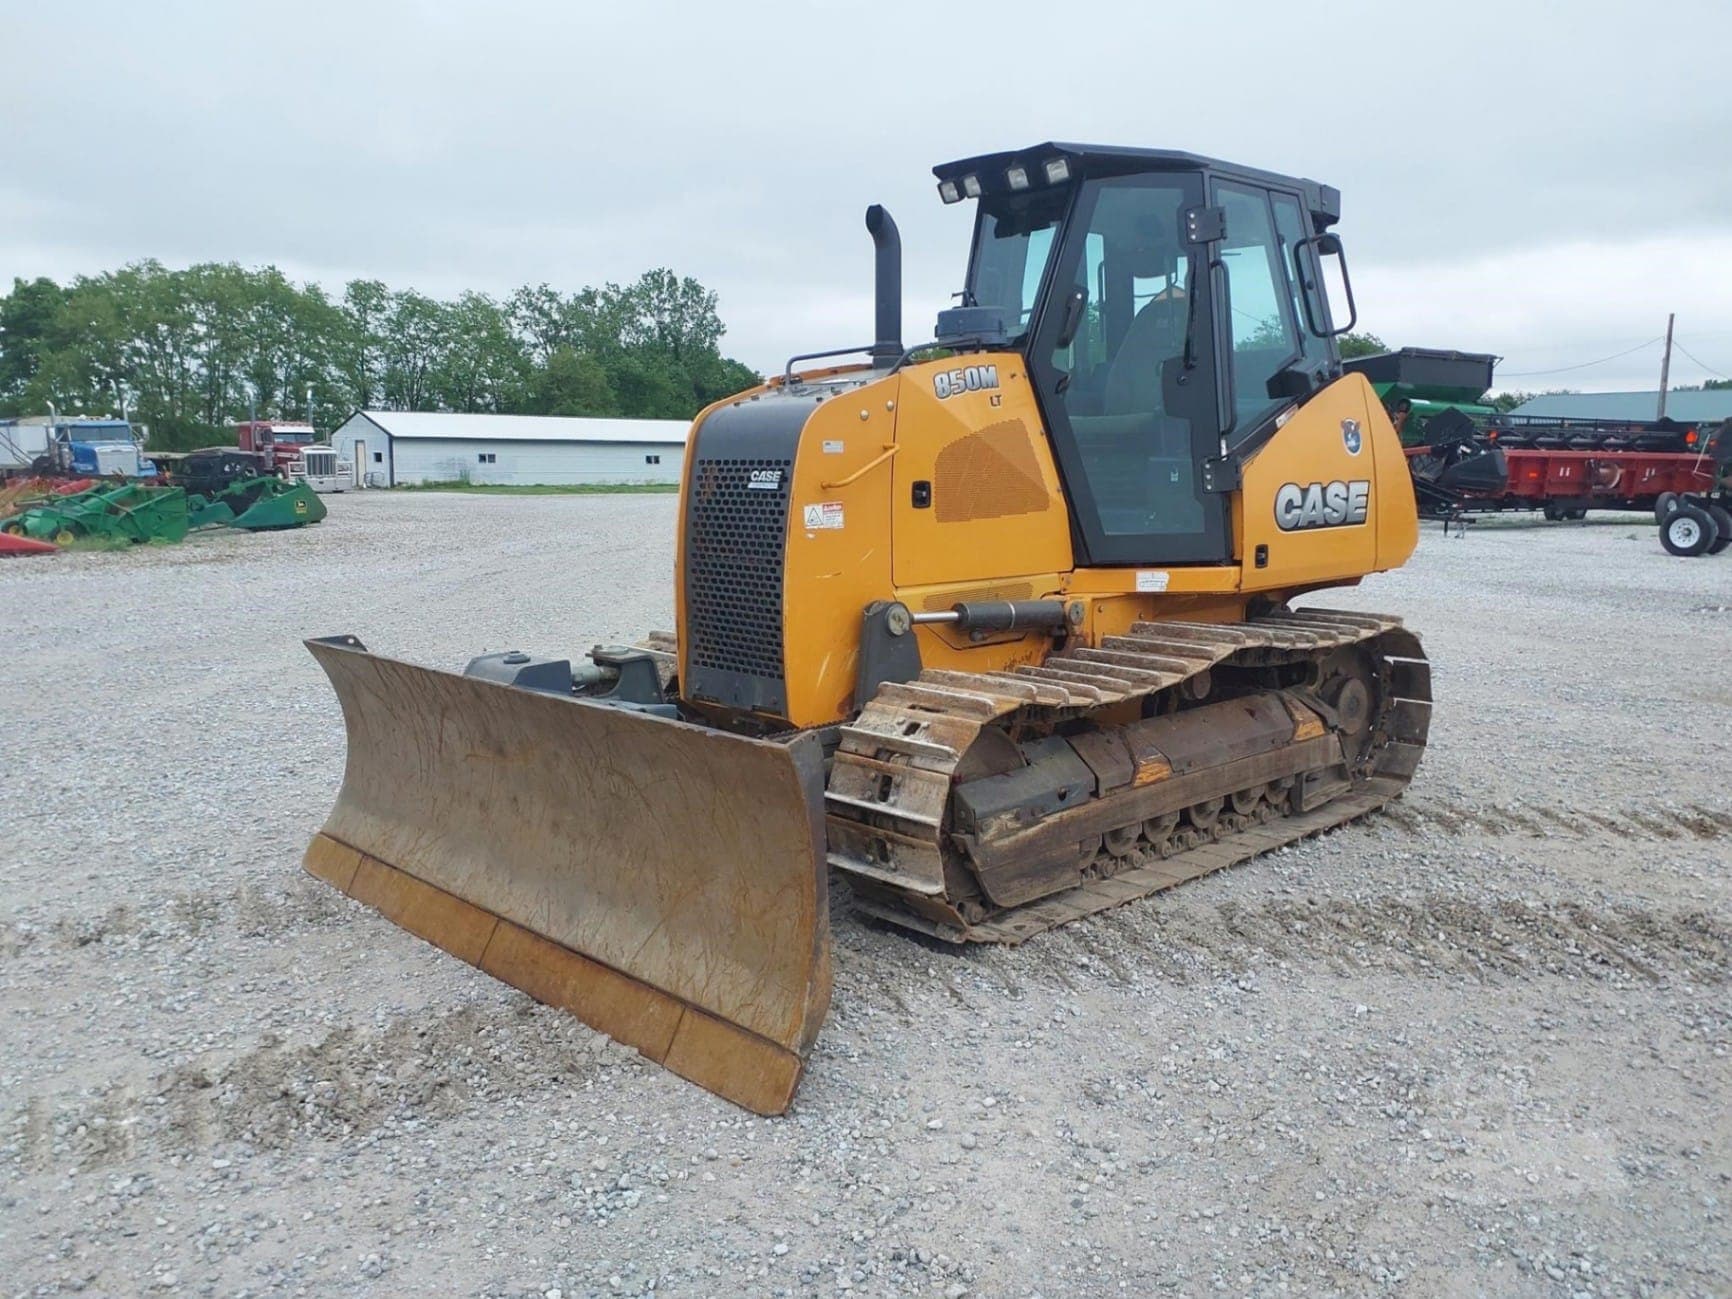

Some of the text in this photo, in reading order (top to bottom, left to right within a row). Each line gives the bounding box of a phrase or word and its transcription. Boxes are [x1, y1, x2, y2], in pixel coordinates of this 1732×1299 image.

[933, 364, 999, 399] 850M
[990, 394, 1001, 407] LT
[750, 470, 782, 482] CASE
[1274, 480, 1370, 531] CASE
